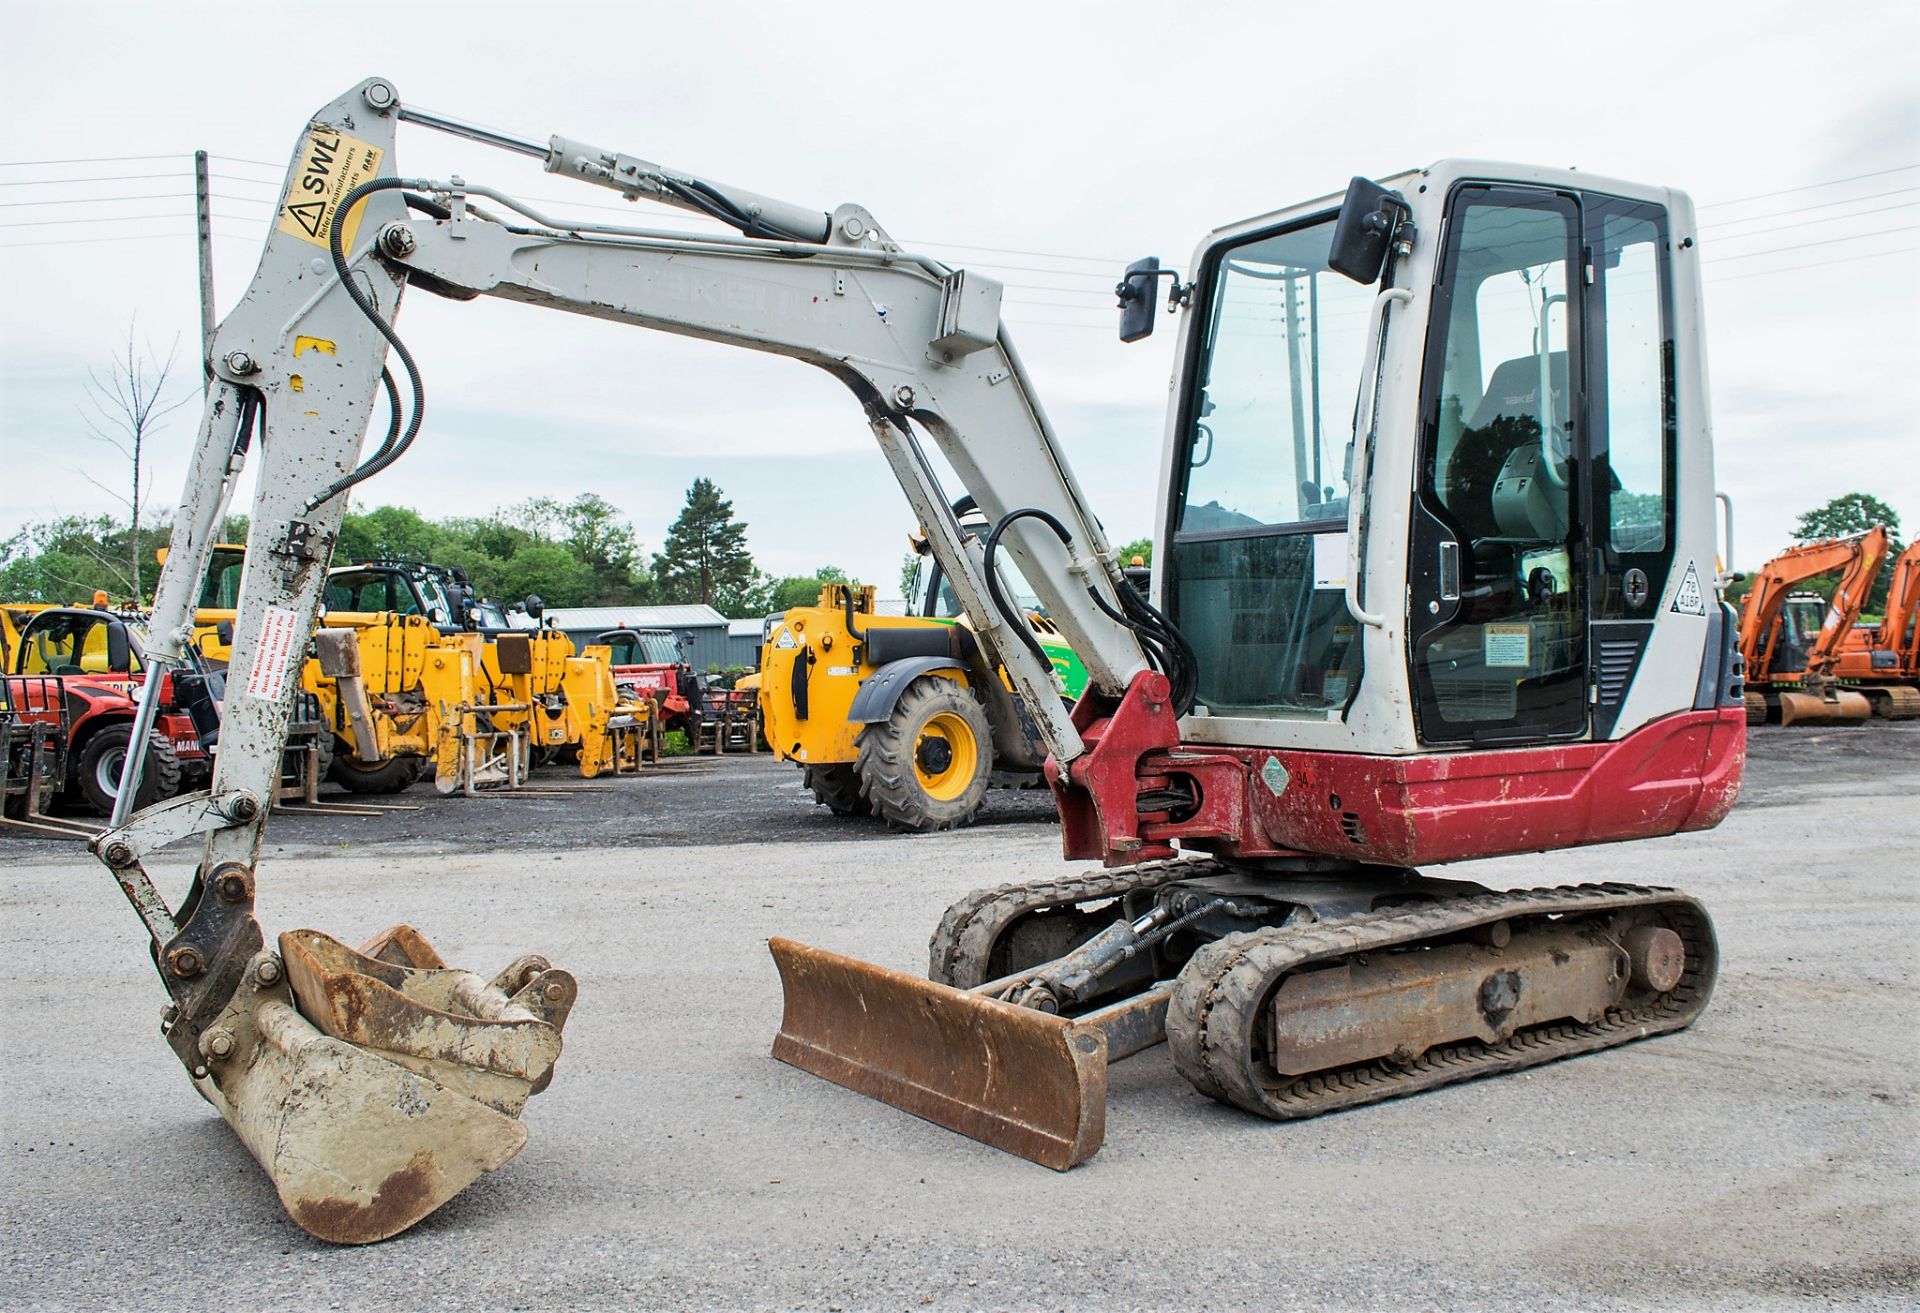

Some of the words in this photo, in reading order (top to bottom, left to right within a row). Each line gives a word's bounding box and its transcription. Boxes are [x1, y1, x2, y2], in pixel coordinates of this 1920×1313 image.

[303, 138, 340, 194] SWL
[318, 216, 331, 239] Refer
[327, 206, 335, 216] to
[331, 147, 356, 206] manufacturers
[287, 614, 295, 628] One
[249, 680, 258, 694] This
[254, 649, 265, 677] Machine
[261, 617, 273, 647] Requires
[281, 630, 292, 657] Without
[261, 674, 270, 693] Quick
[266, 653, 275, 671] Hitch
[271, 629, 282, 651] Safety
[277, 660, 285, 673] Use
[271, 689, 278, 699] Do
[274, 675, 282, 688] Not
